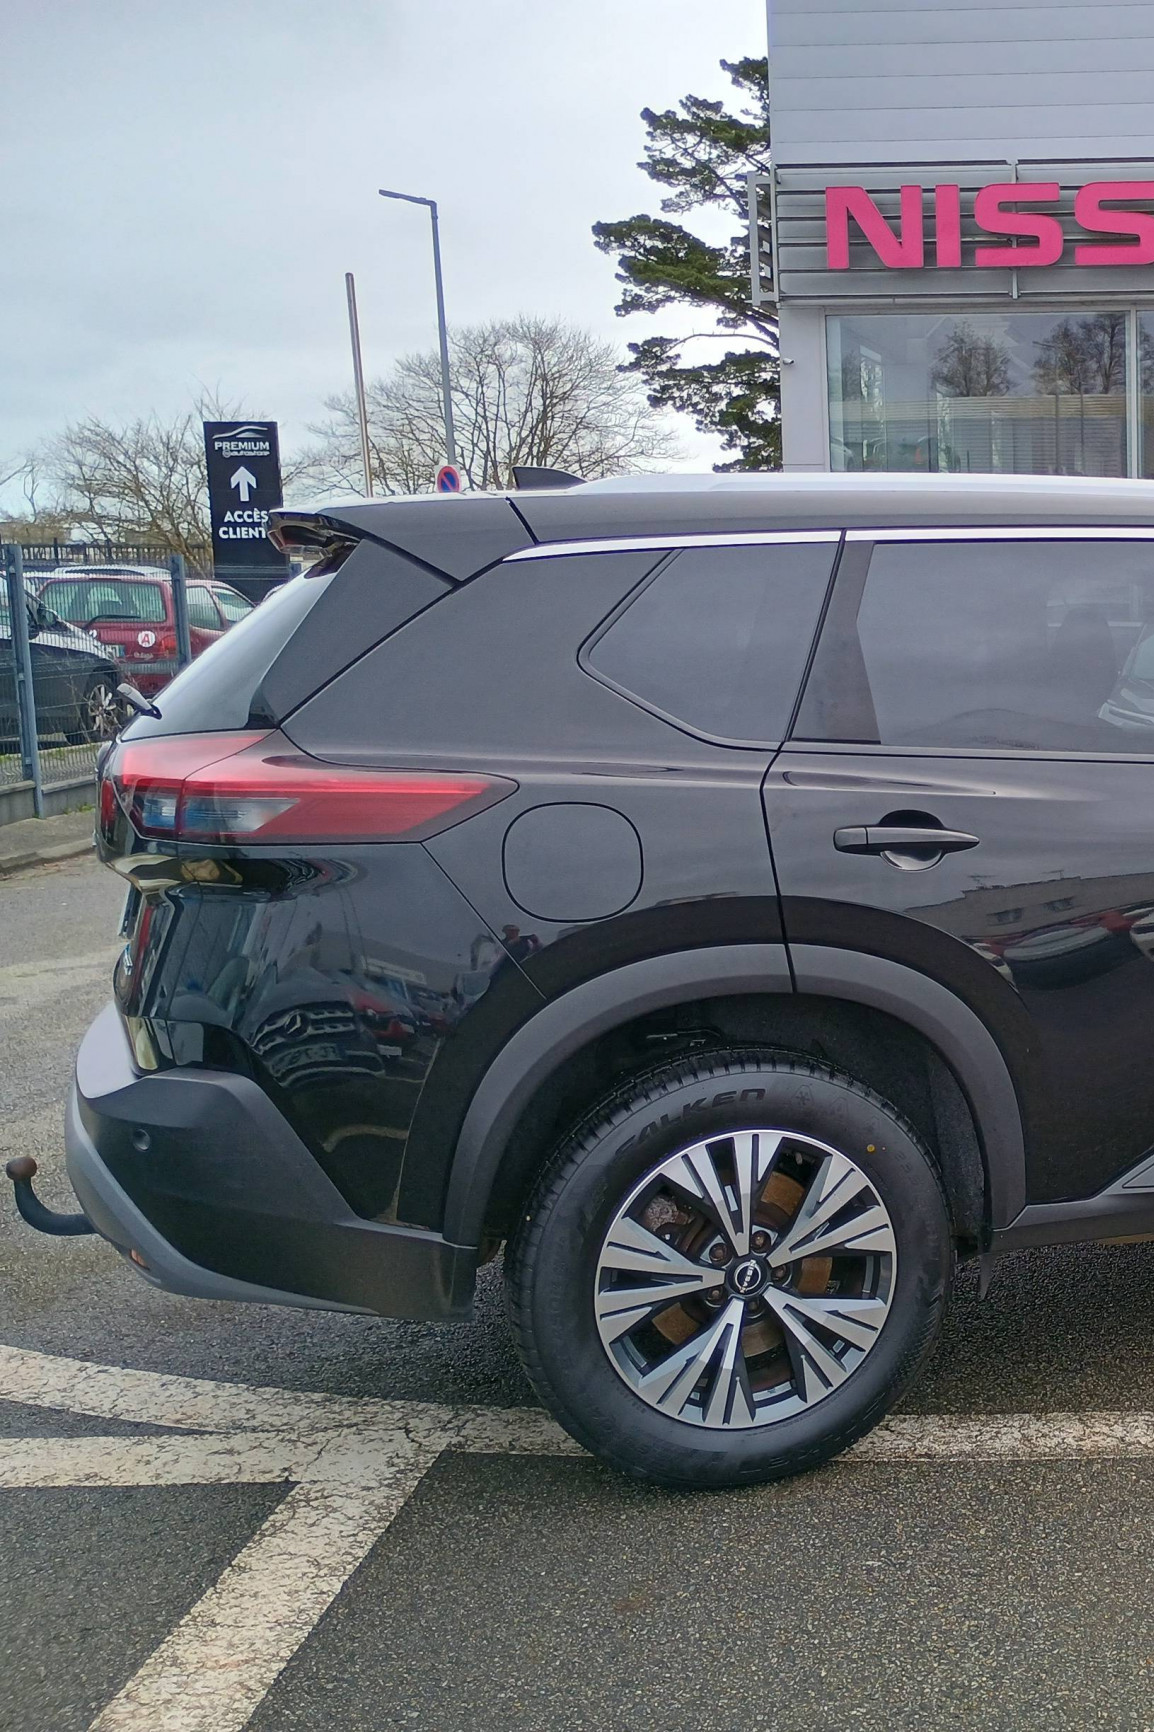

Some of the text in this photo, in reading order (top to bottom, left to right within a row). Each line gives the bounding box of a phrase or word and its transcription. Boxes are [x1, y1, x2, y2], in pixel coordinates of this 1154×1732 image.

[214, 441, 270, 451] PREMIUM
[223, 508, 269, 523] ACCÈS
[141, 633, 152, 646] A
